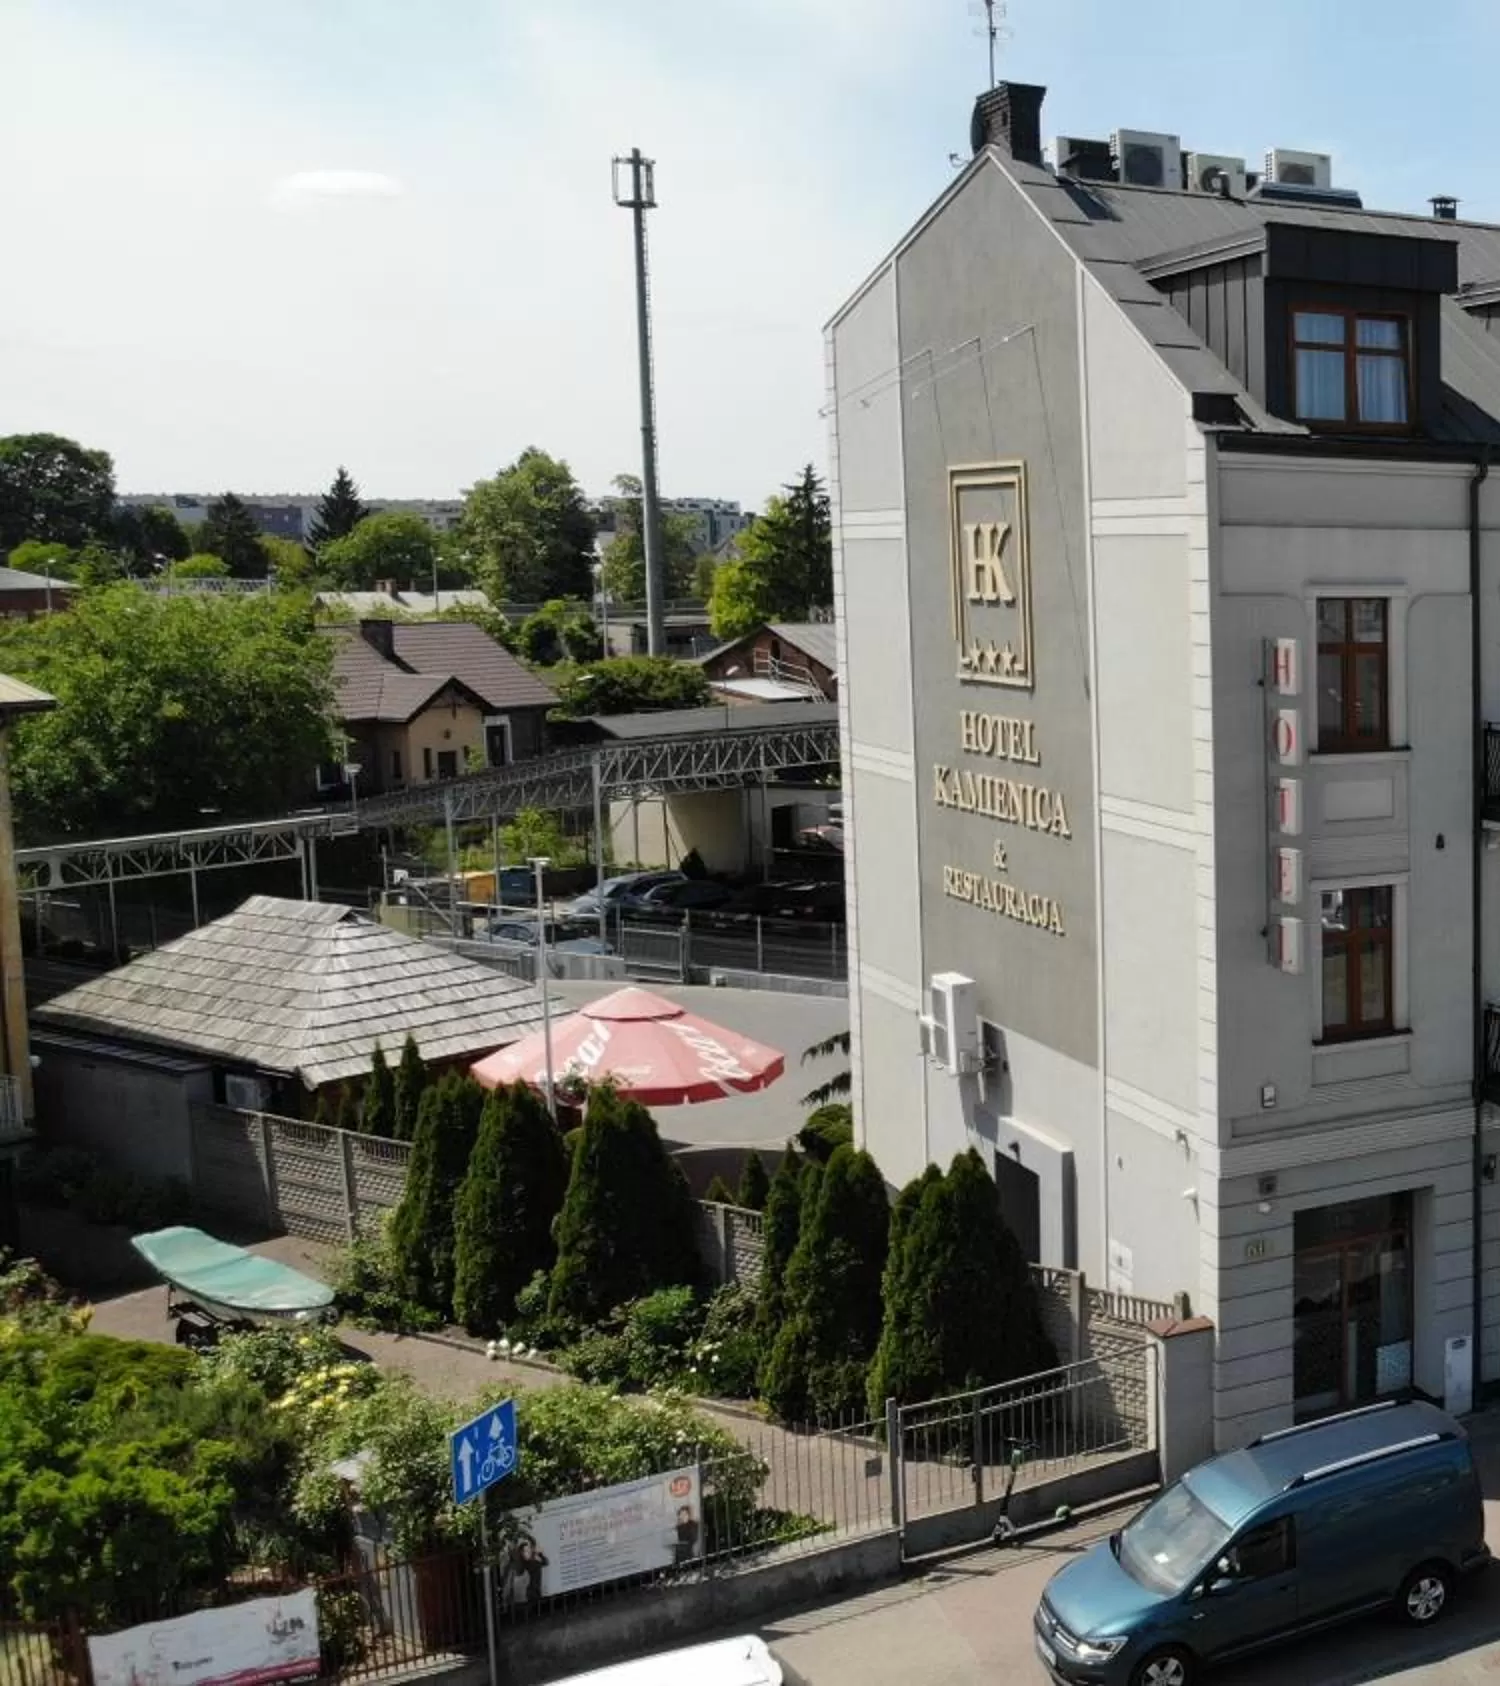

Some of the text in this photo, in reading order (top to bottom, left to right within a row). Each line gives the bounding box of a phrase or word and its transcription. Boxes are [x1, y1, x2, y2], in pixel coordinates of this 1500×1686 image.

[959, 709, 1040, 764] HOTEL
[933, 763, 1072, 837] KAMIENICA
[992, 838, 1009, 870] &
[943, 864, 1066, 935] RESTAURACJA
